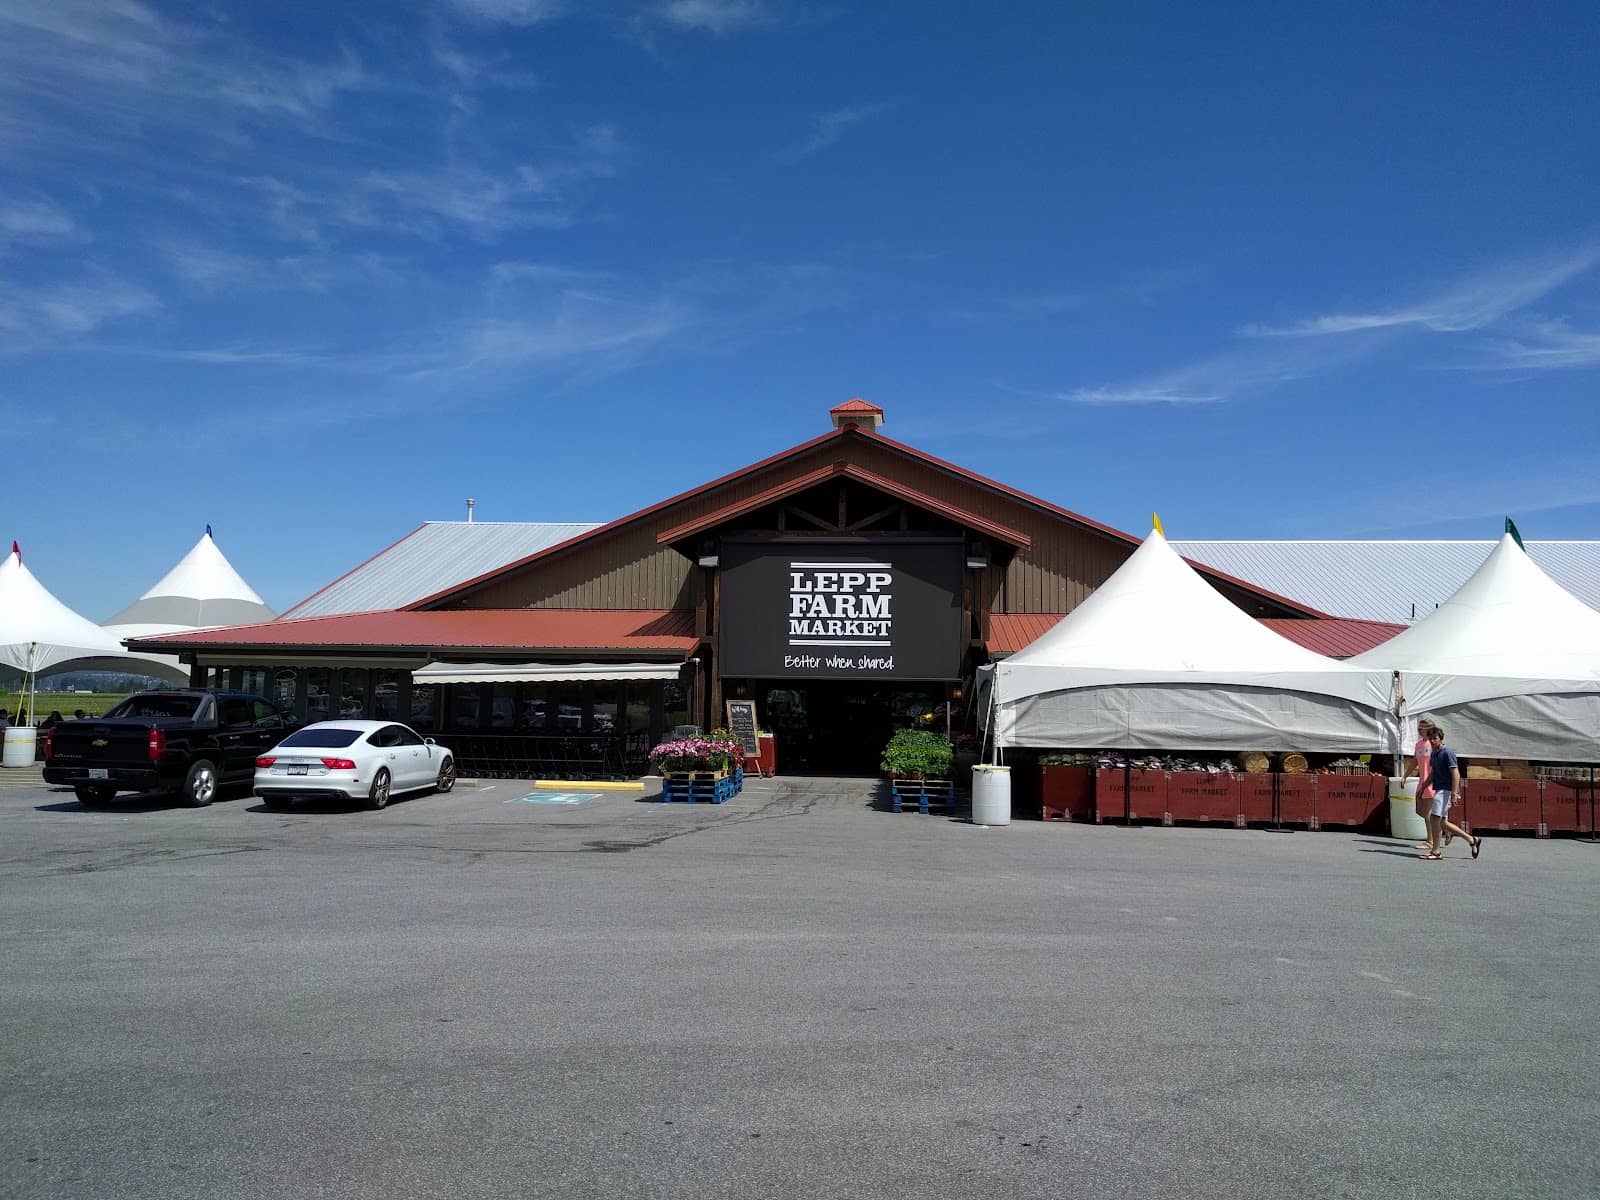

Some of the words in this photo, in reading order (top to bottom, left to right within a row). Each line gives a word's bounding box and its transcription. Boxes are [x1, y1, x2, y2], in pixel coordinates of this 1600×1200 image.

[790, 572, 893, 593] LEPP
[789, 594, 892, 618] FARM
[789, 619, 892, 636] MARKET
[785, 655, 821, 668] Better
[825, 655, 856, 669] when
